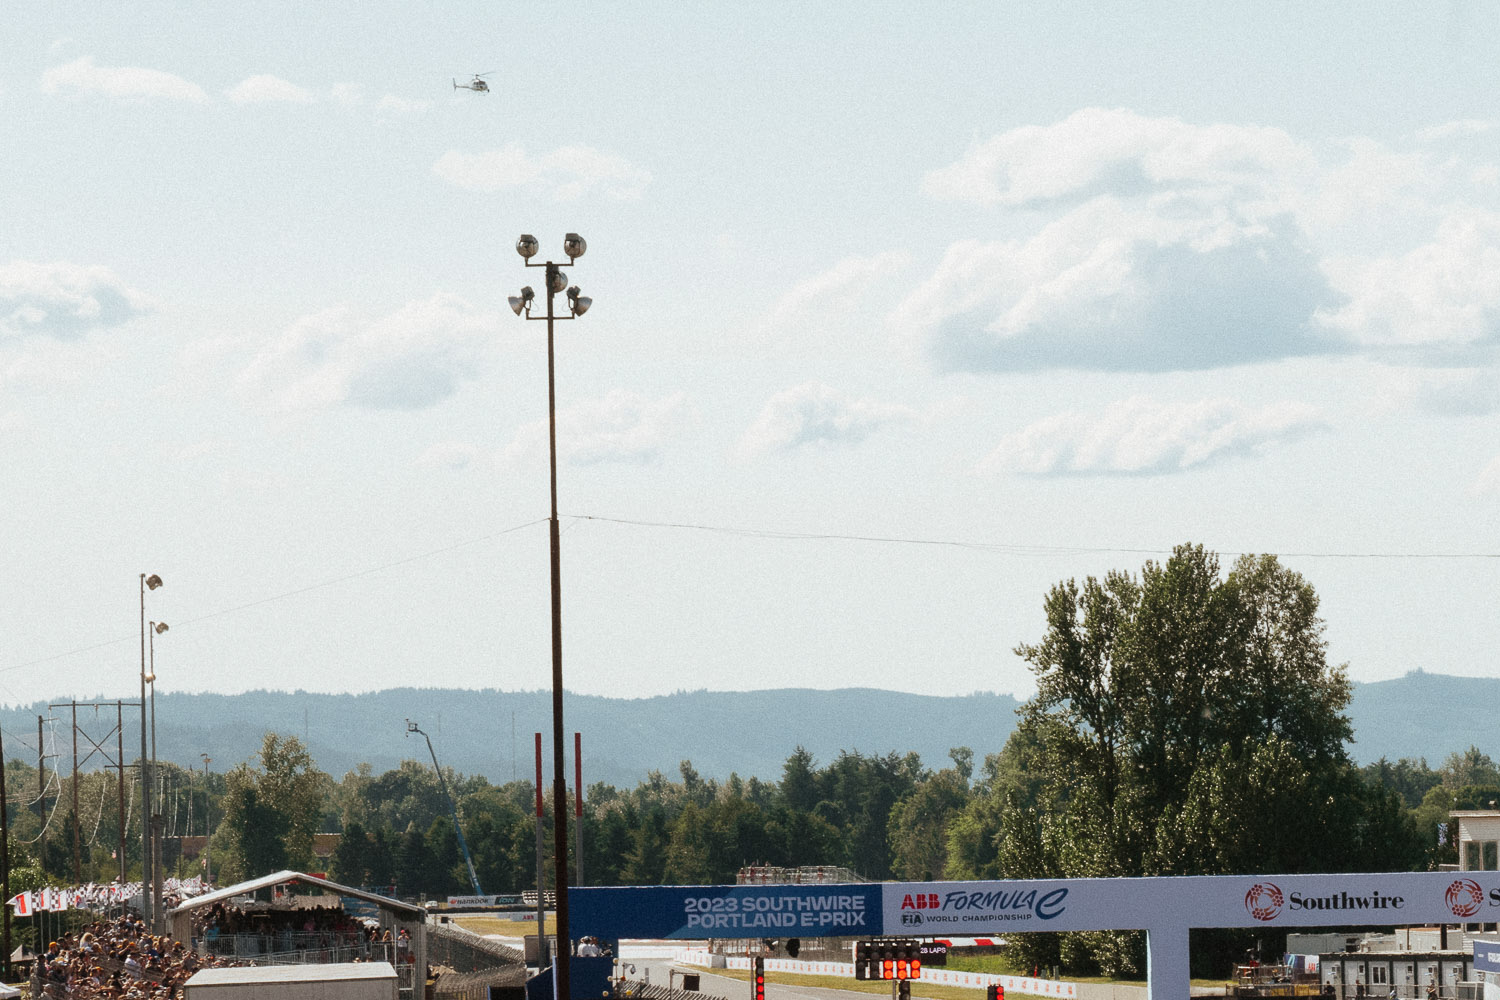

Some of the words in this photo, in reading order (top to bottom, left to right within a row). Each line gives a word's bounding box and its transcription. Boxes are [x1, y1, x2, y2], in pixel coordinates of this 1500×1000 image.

[684, 897, 739, 913] 2023
[741, 895, 865, 912] SOUTHWIRE
[901, 893, 940, 910] ABB
[943, 891, 1034, 912] FORMULA
[1289, 890, 1404, 911] Southwire
[687, 912, 797, 928] PORTLAND
[801, 910, 866, 927] E-PRIX
[926, 914, 959, 923] WORLD
[962, 912, 1032, 922] CHAMPIONSHIP
